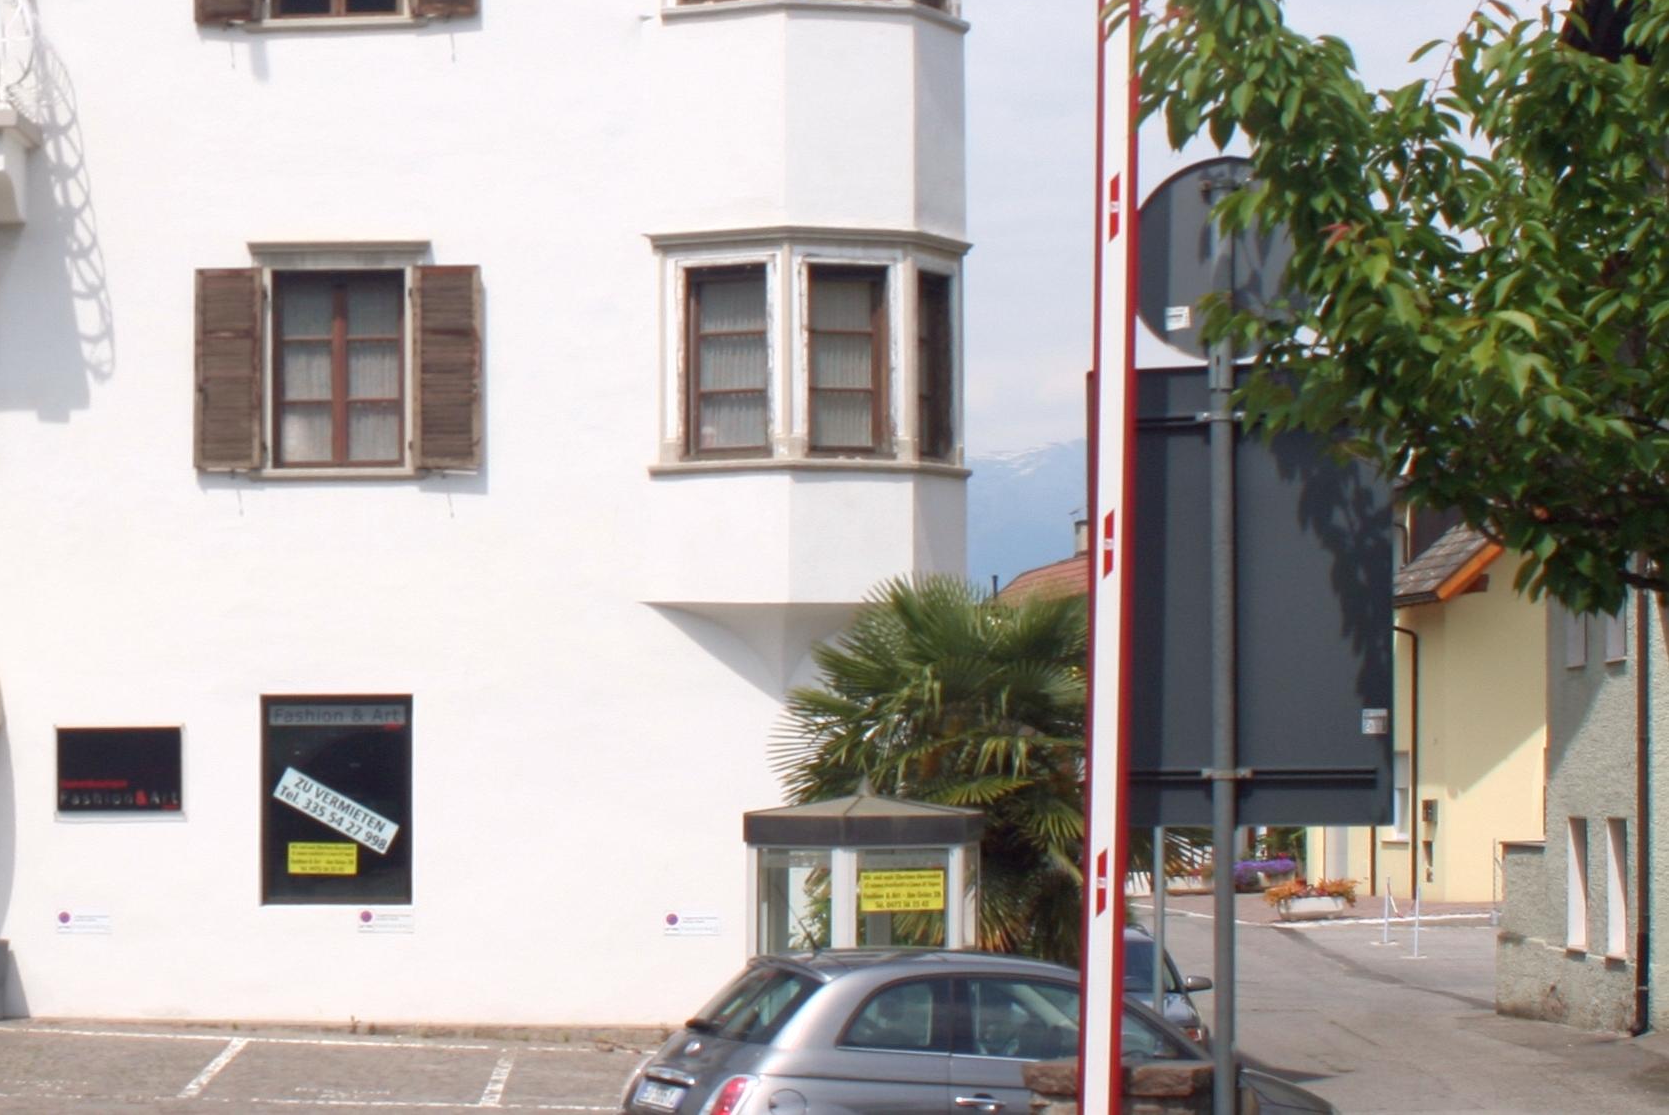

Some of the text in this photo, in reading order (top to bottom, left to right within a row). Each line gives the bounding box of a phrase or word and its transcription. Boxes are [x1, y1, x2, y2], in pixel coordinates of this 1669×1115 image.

[274, 708, 401, 723] Fashion & Art
[280, 785, 388, 851] Tel. 335 54 27 998
[294, 776, 387, 833] ZU VERMIETEN
